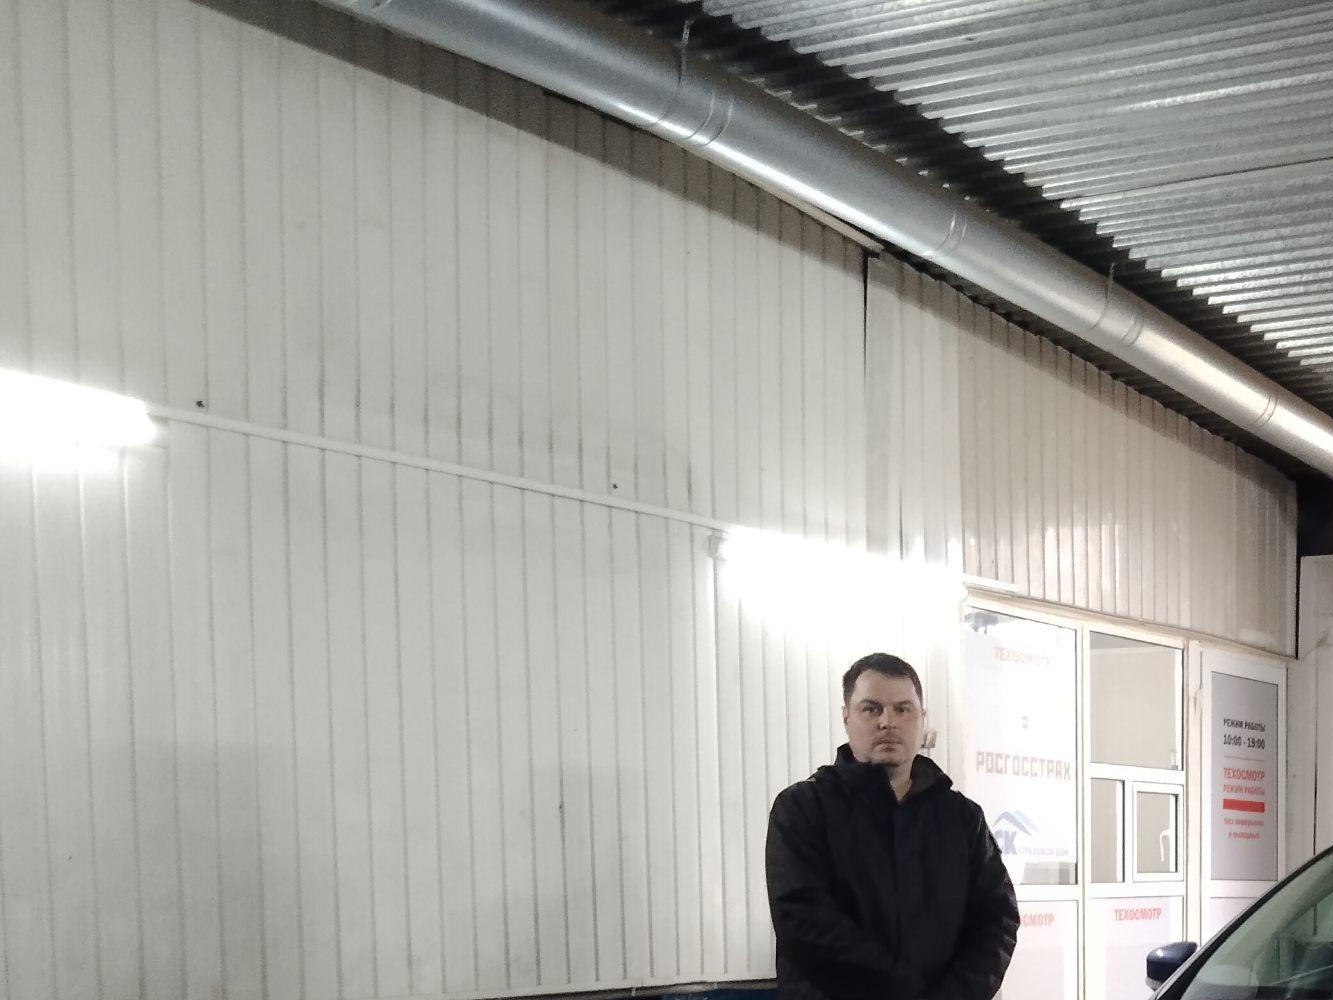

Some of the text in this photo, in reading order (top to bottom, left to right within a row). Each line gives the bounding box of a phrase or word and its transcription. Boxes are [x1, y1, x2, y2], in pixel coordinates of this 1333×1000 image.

[1223, 718, 1266, 732] РЕЖИМ РАБОТЫ
[1223, 734, 1242, 746] 10:00
[1247, 737, 1266, 750] 19:00
[976, 750, 1071, 781] РОСГОССТРАХ
[1223, 768, 1266, 781] ТЕХОСМОТР
[1020, 911, 1055, 928] СМОТР
[1114, 907, 1162, 921] ТЕХОСМОТР
